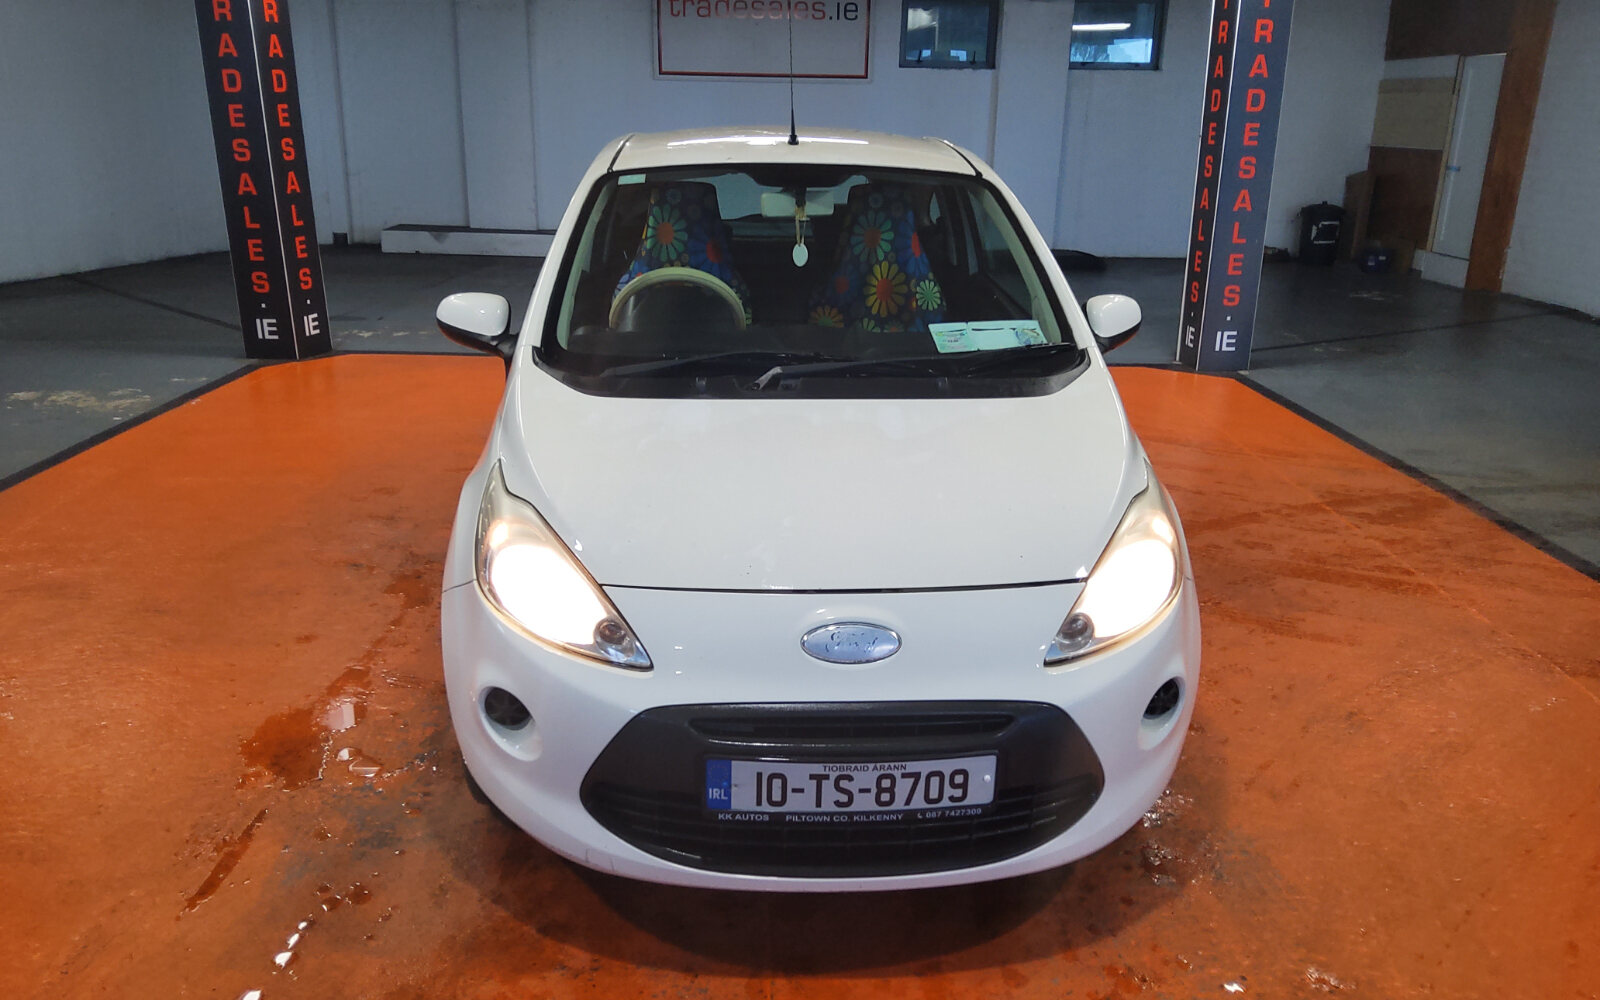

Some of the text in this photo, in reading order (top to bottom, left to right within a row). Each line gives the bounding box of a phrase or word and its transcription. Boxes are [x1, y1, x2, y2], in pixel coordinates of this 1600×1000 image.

[823, 763, 907, 773] TIOBRAID ÁRANN
[708, 787, 729, 800] IRL
[755, 768, 970, 809] 10-TS-8709
[718, 813, 769, 822] KK AUTOS
[785, 814, 831, 823] PILTOWN
[853, 813, 904, 823] KILKENNY
[926, 811, 942, 819] 087
